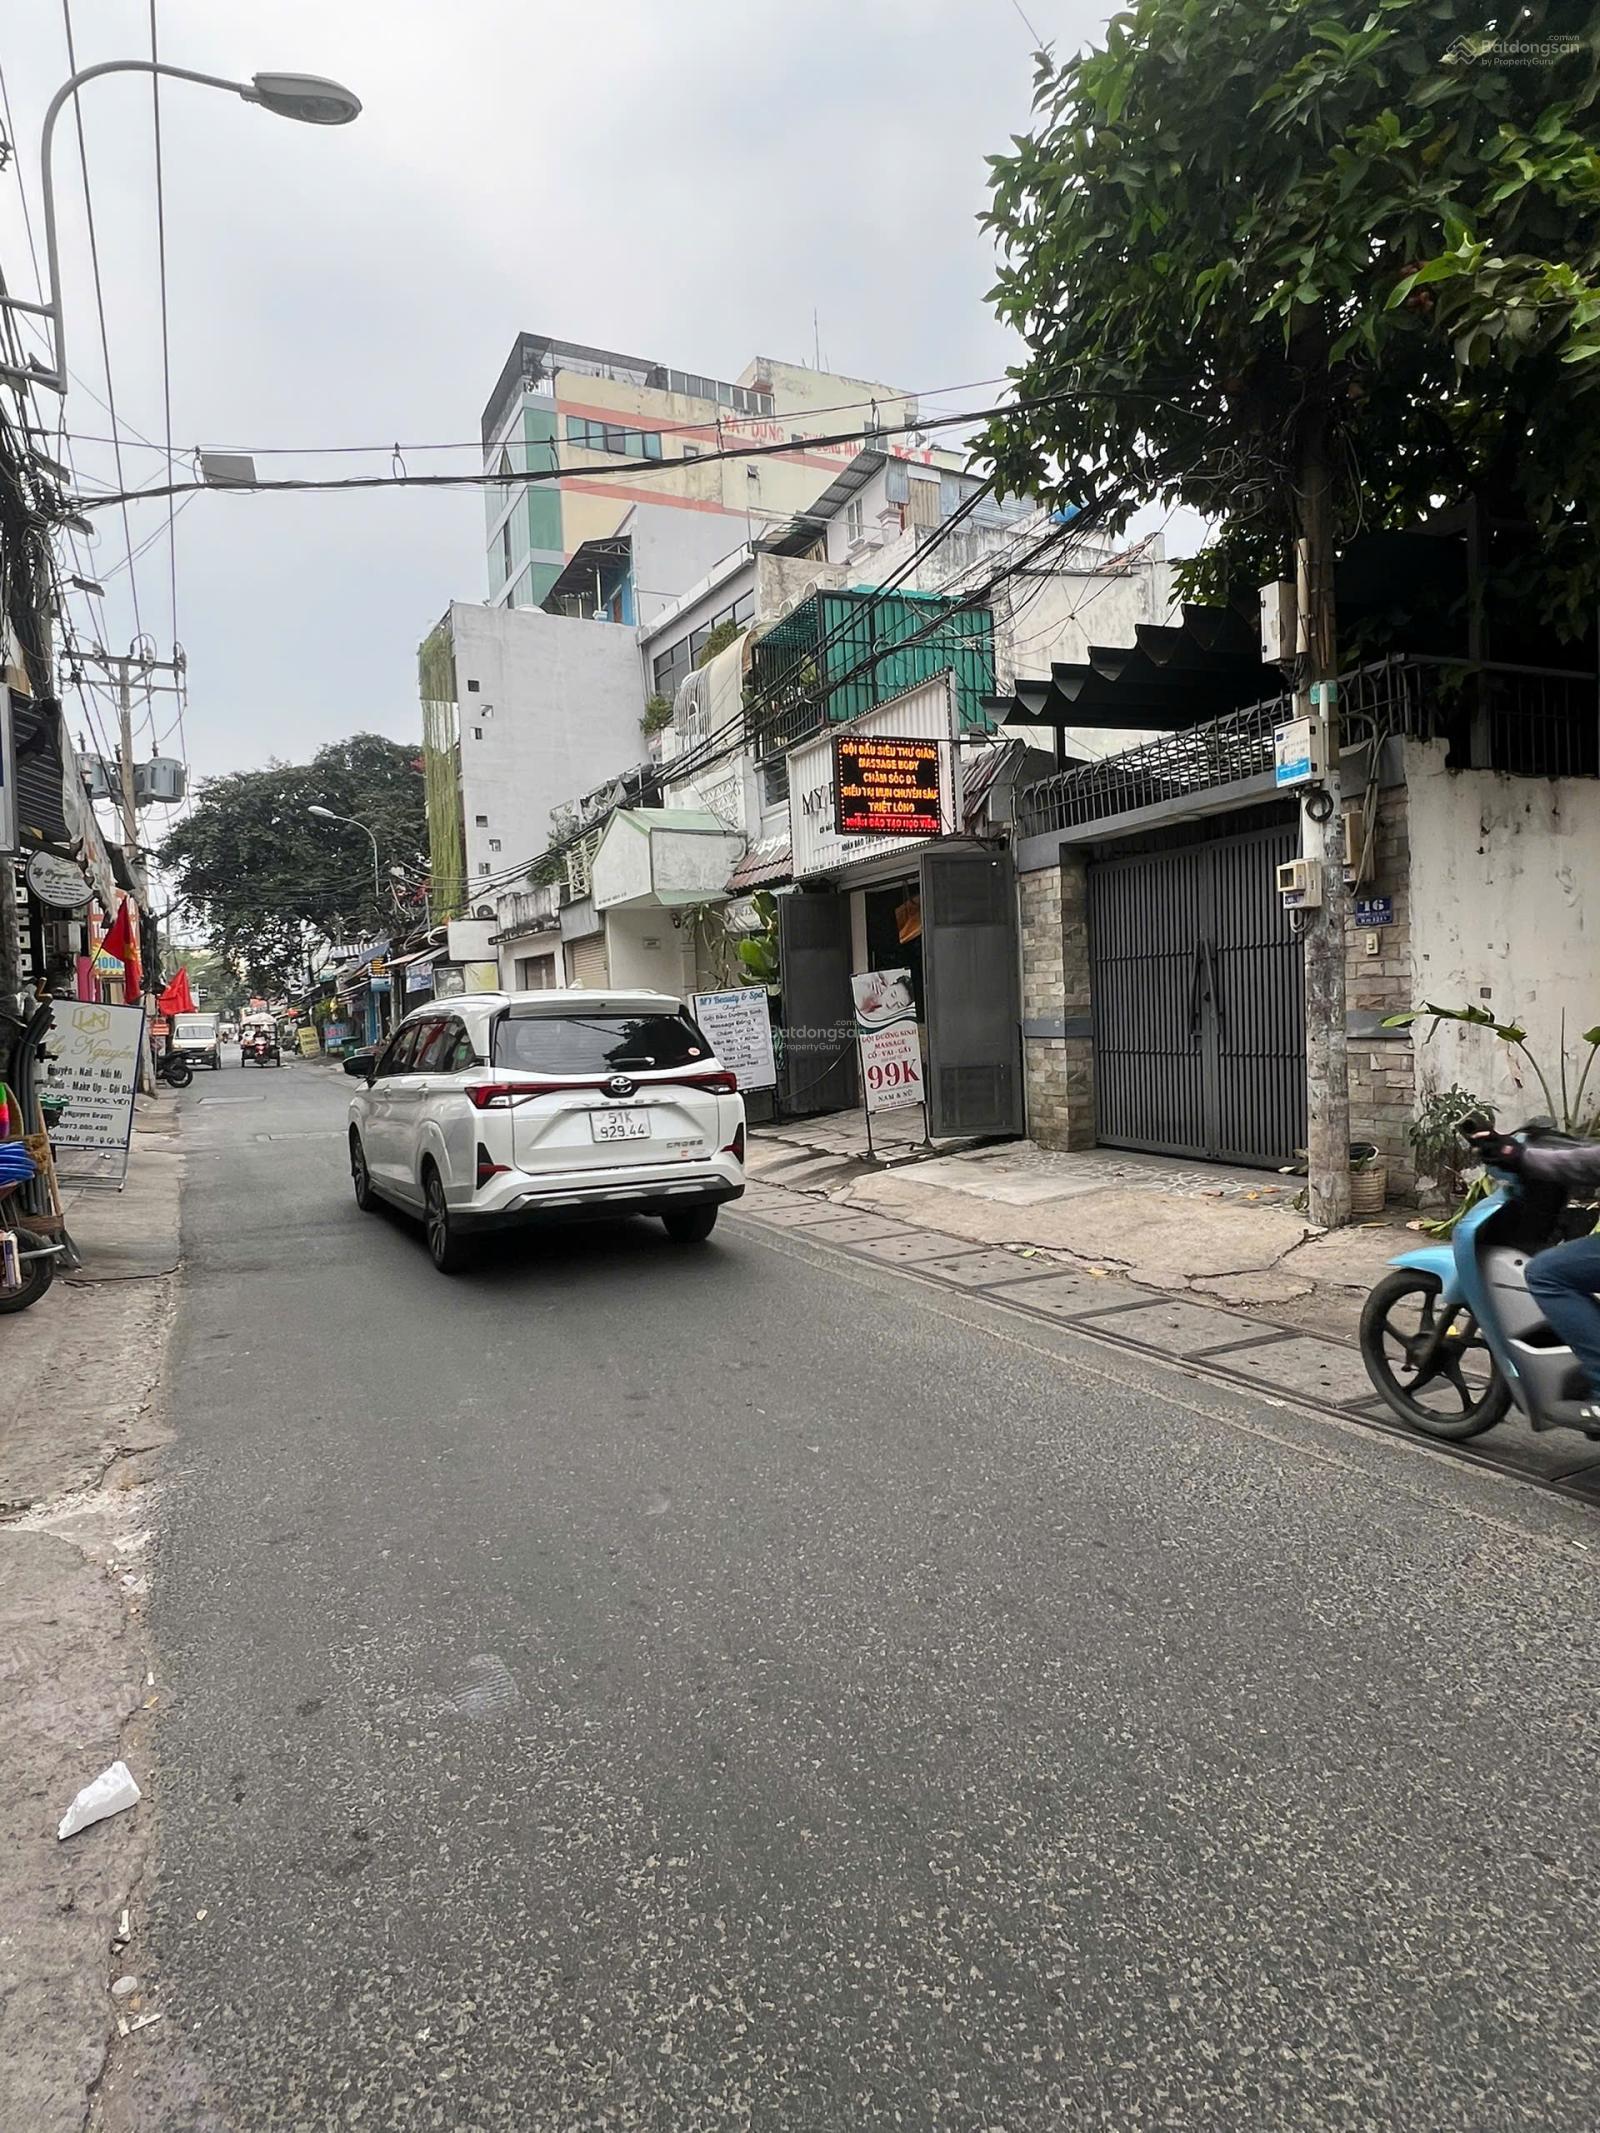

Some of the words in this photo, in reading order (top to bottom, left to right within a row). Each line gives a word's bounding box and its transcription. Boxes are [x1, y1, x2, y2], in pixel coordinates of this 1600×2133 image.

[859, 759, 897, 769] MASSAGE
[898, 760, 920, 770] BODY
[741, 993, 747, 1001] &
[749, 991, 764, 1001] Spa
[874, 1039, 906, 1049] MASSAGE
[79, 1067, 93, 1077] Nail
[867, 1059, 920, 1090] 99K
[72, 1081, 91, 1092] Make
[92, 1083, 102, 1094] Up
[878, 1094, 894, 1102] NAM
[608, 1112, 633, 1124] 51K
[600, 1124, 645, 1138] 929.44
